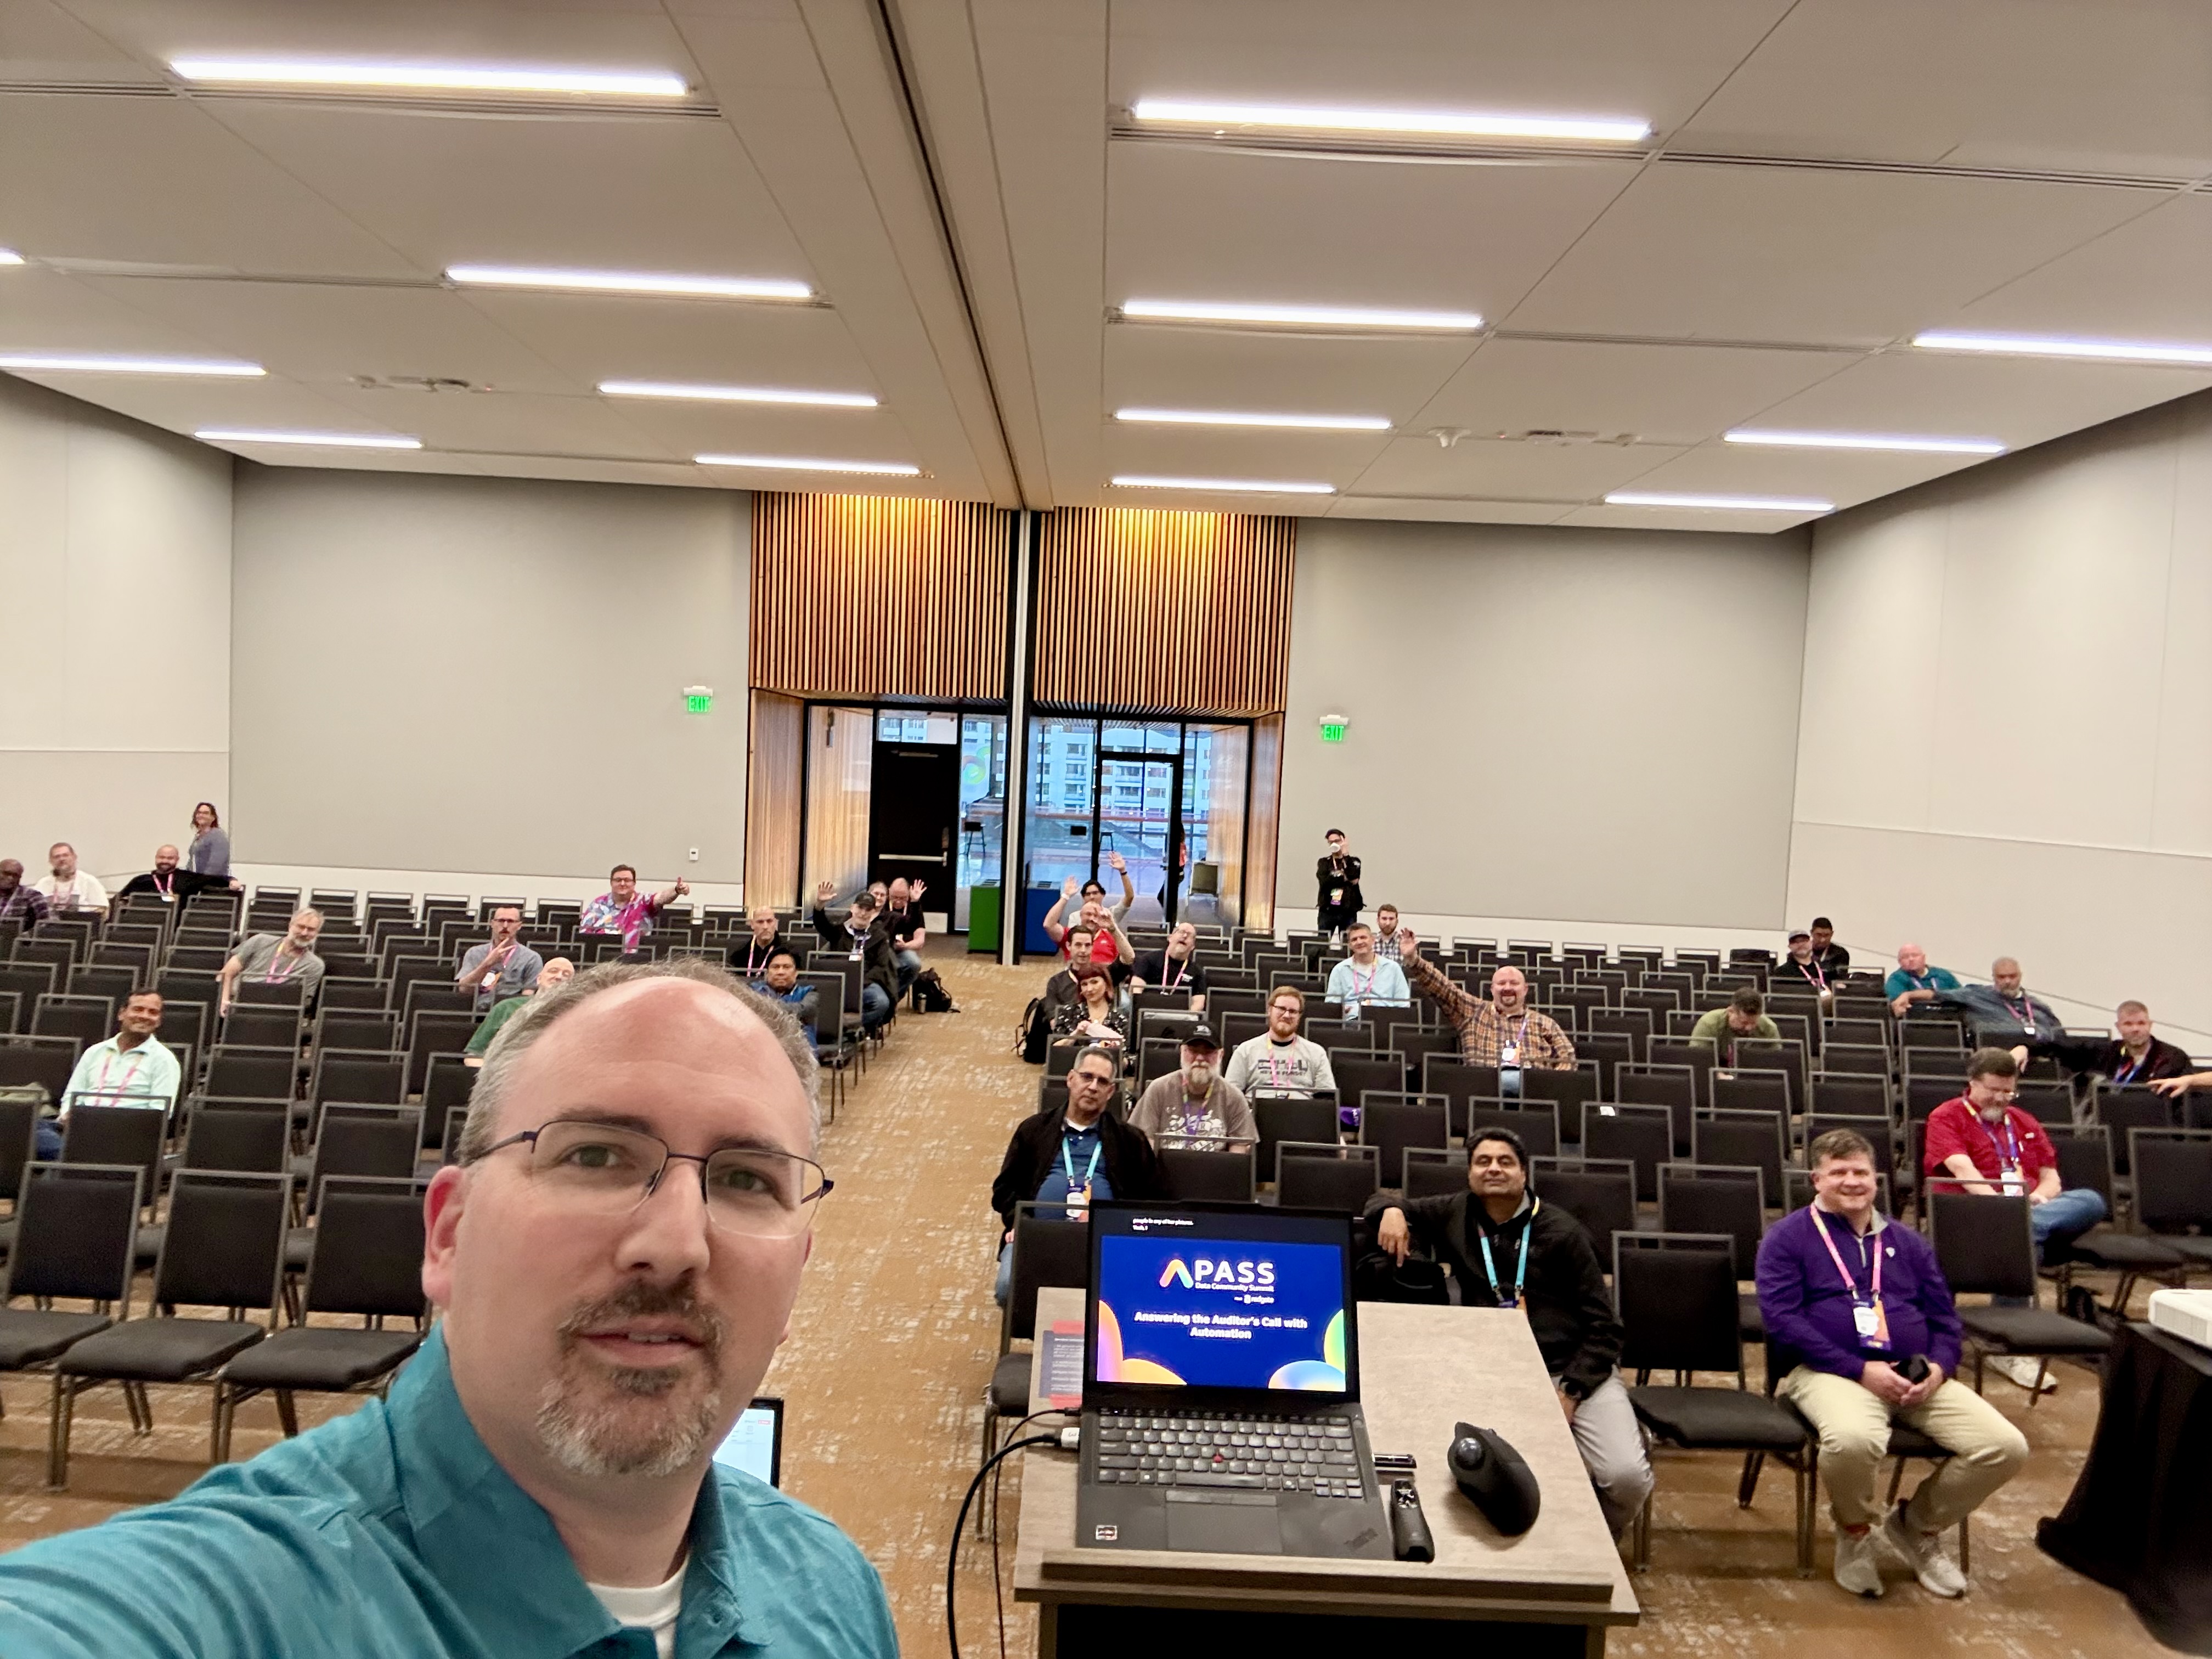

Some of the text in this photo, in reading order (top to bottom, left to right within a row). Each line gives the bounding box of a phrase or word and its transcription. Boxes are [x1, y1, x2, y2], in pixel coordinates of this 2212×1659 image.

[689, 696, 709, 712] EXIT
[1324, 725, 1344, 741] EXIT
[1195, 1260, 1275, 1284] PASS
[1211, 1283, 1248, 1292] Community
[1135, 1312, 1307, 1328] Answering the Auditor's Call with
[1190, 1327, 1251, 1339] Automation
